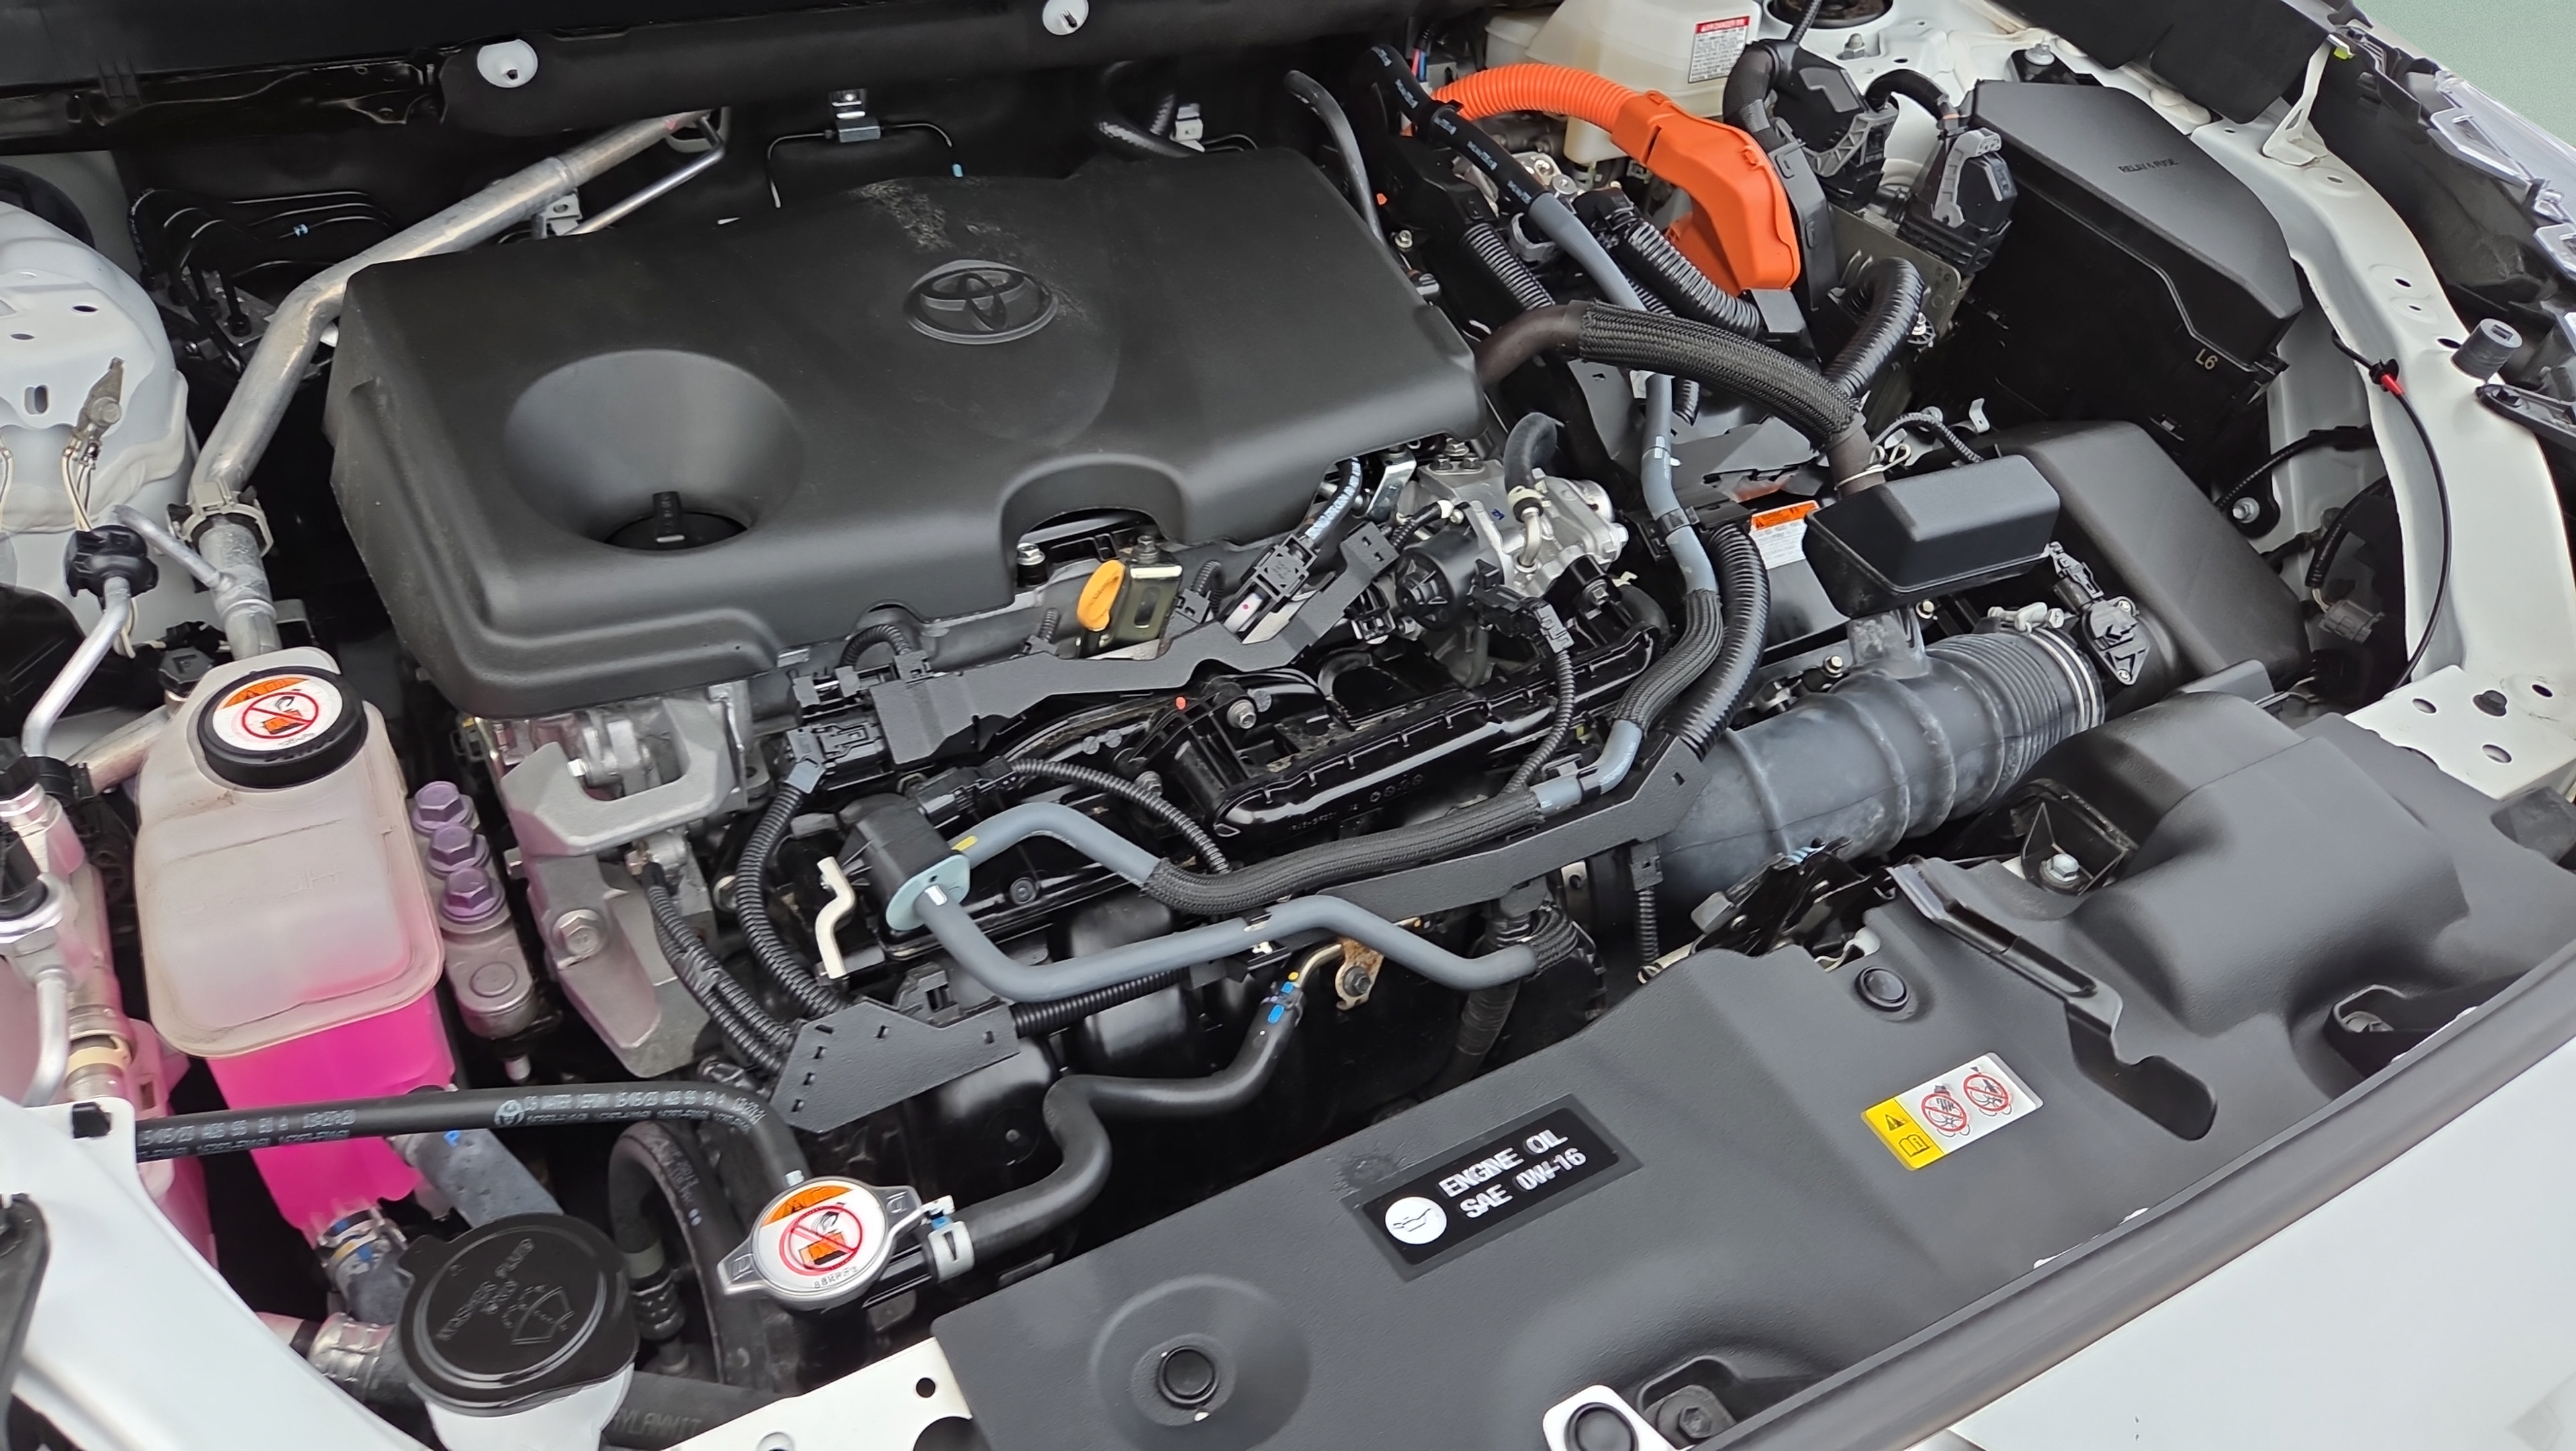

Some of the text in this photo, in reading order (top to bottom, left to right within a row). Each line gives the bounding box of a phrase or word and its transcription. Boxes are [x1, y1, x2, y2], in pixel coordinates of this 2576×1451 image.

[2195, 348, 2218, 369] L6
[1526, 1129, 1569, 1153] OIL
[1460, 1184, 1513, 1219] SAE
